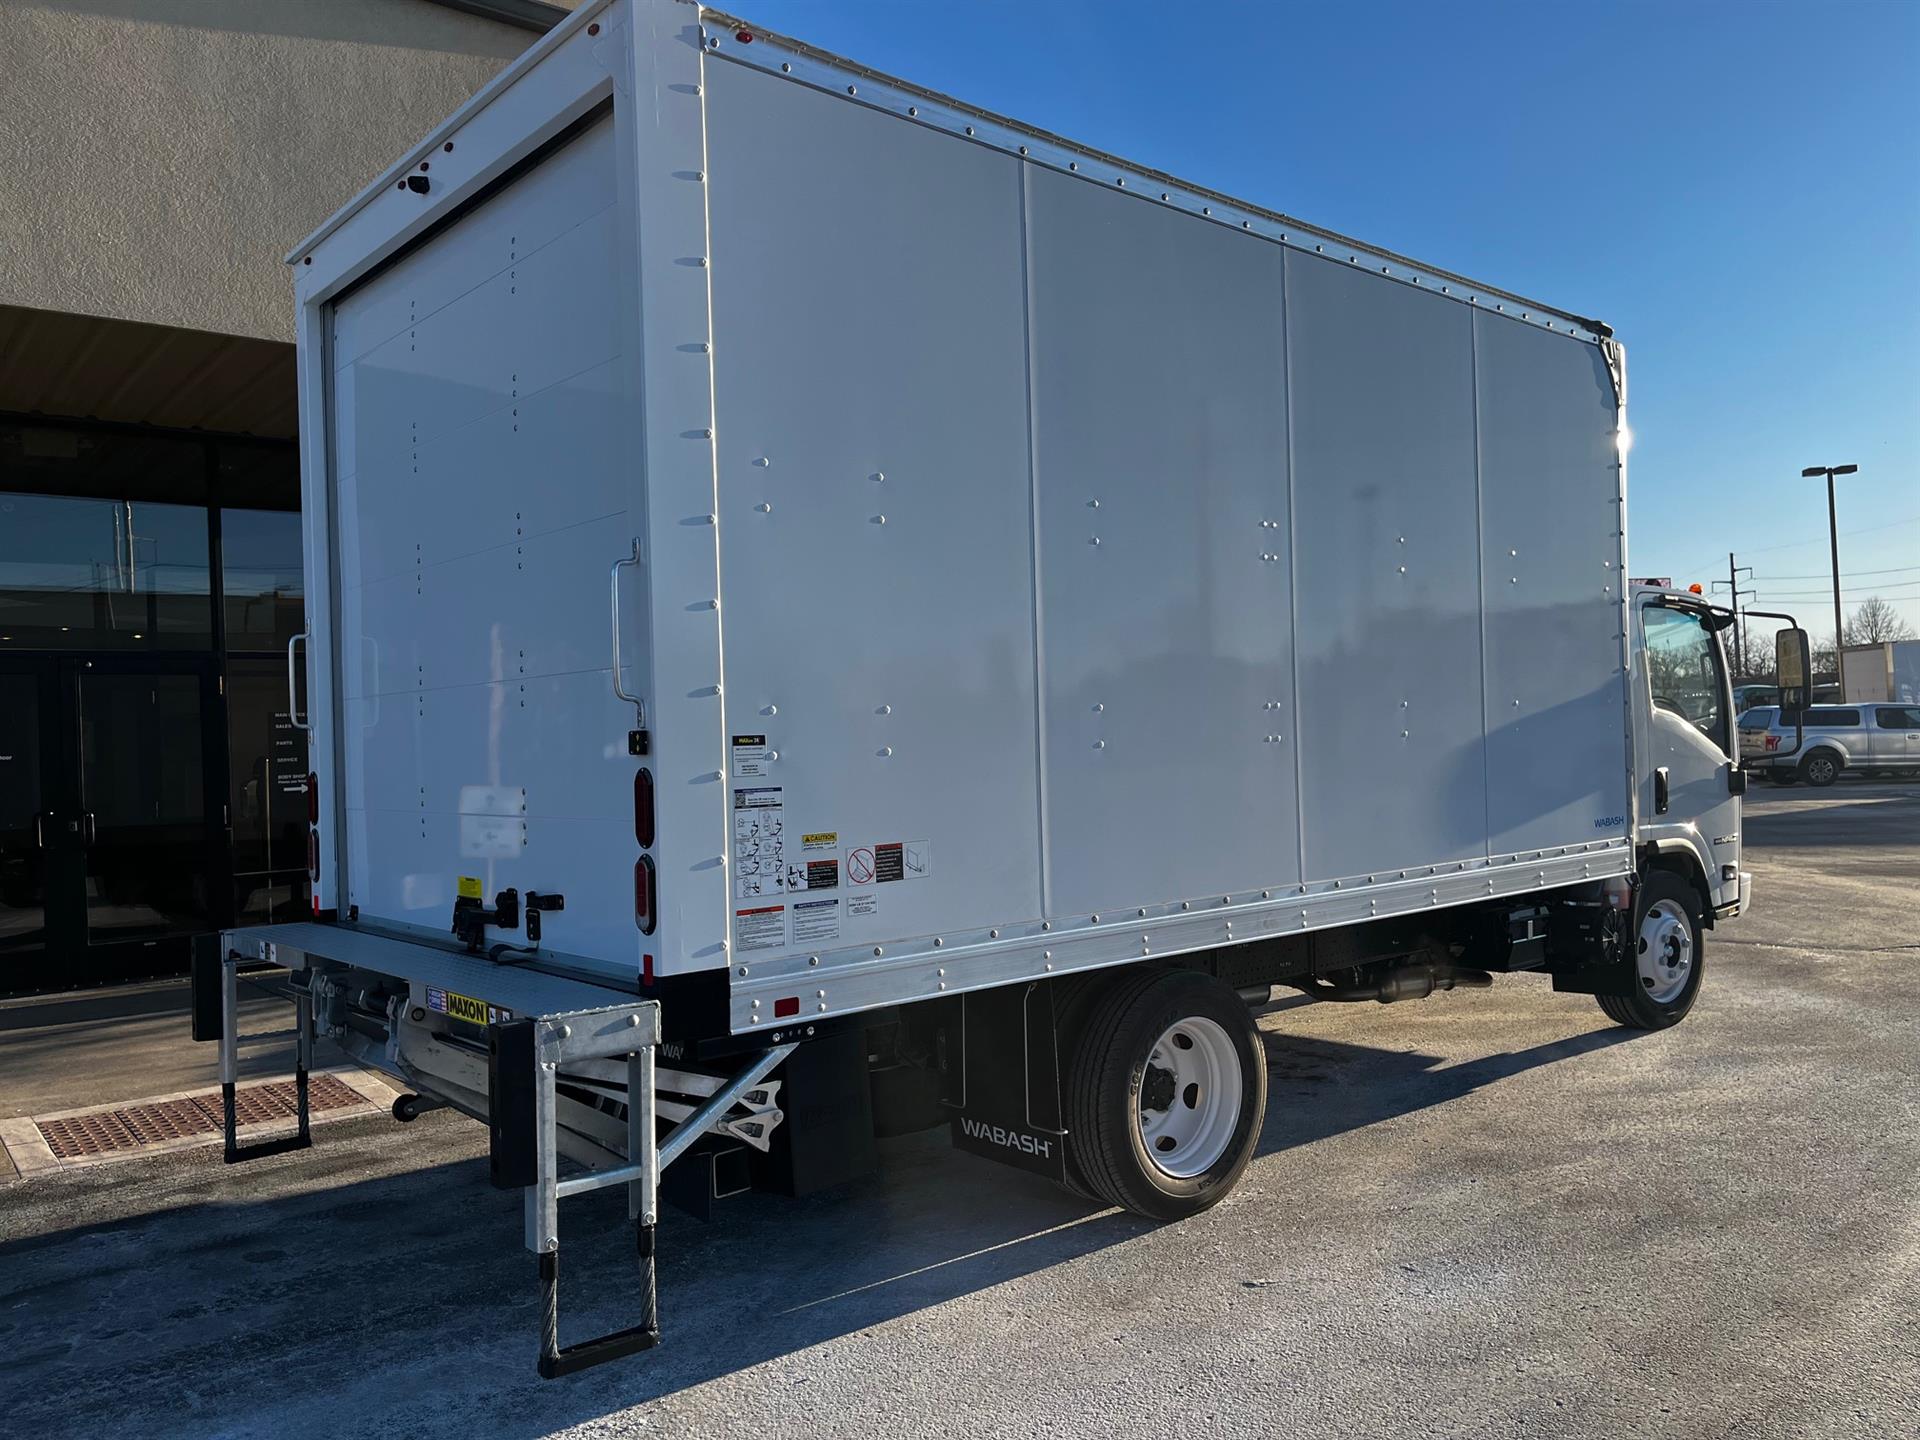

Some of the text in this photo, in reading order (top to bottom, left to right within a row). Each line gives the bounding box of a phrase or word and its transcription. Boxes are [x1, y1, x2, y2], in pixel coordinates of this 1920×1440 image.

[1594, 816, 1624, 828] WABASH
[449, 995, 485, 1022] MAXON
[961, 1117, 1050, 1159] WABASH
